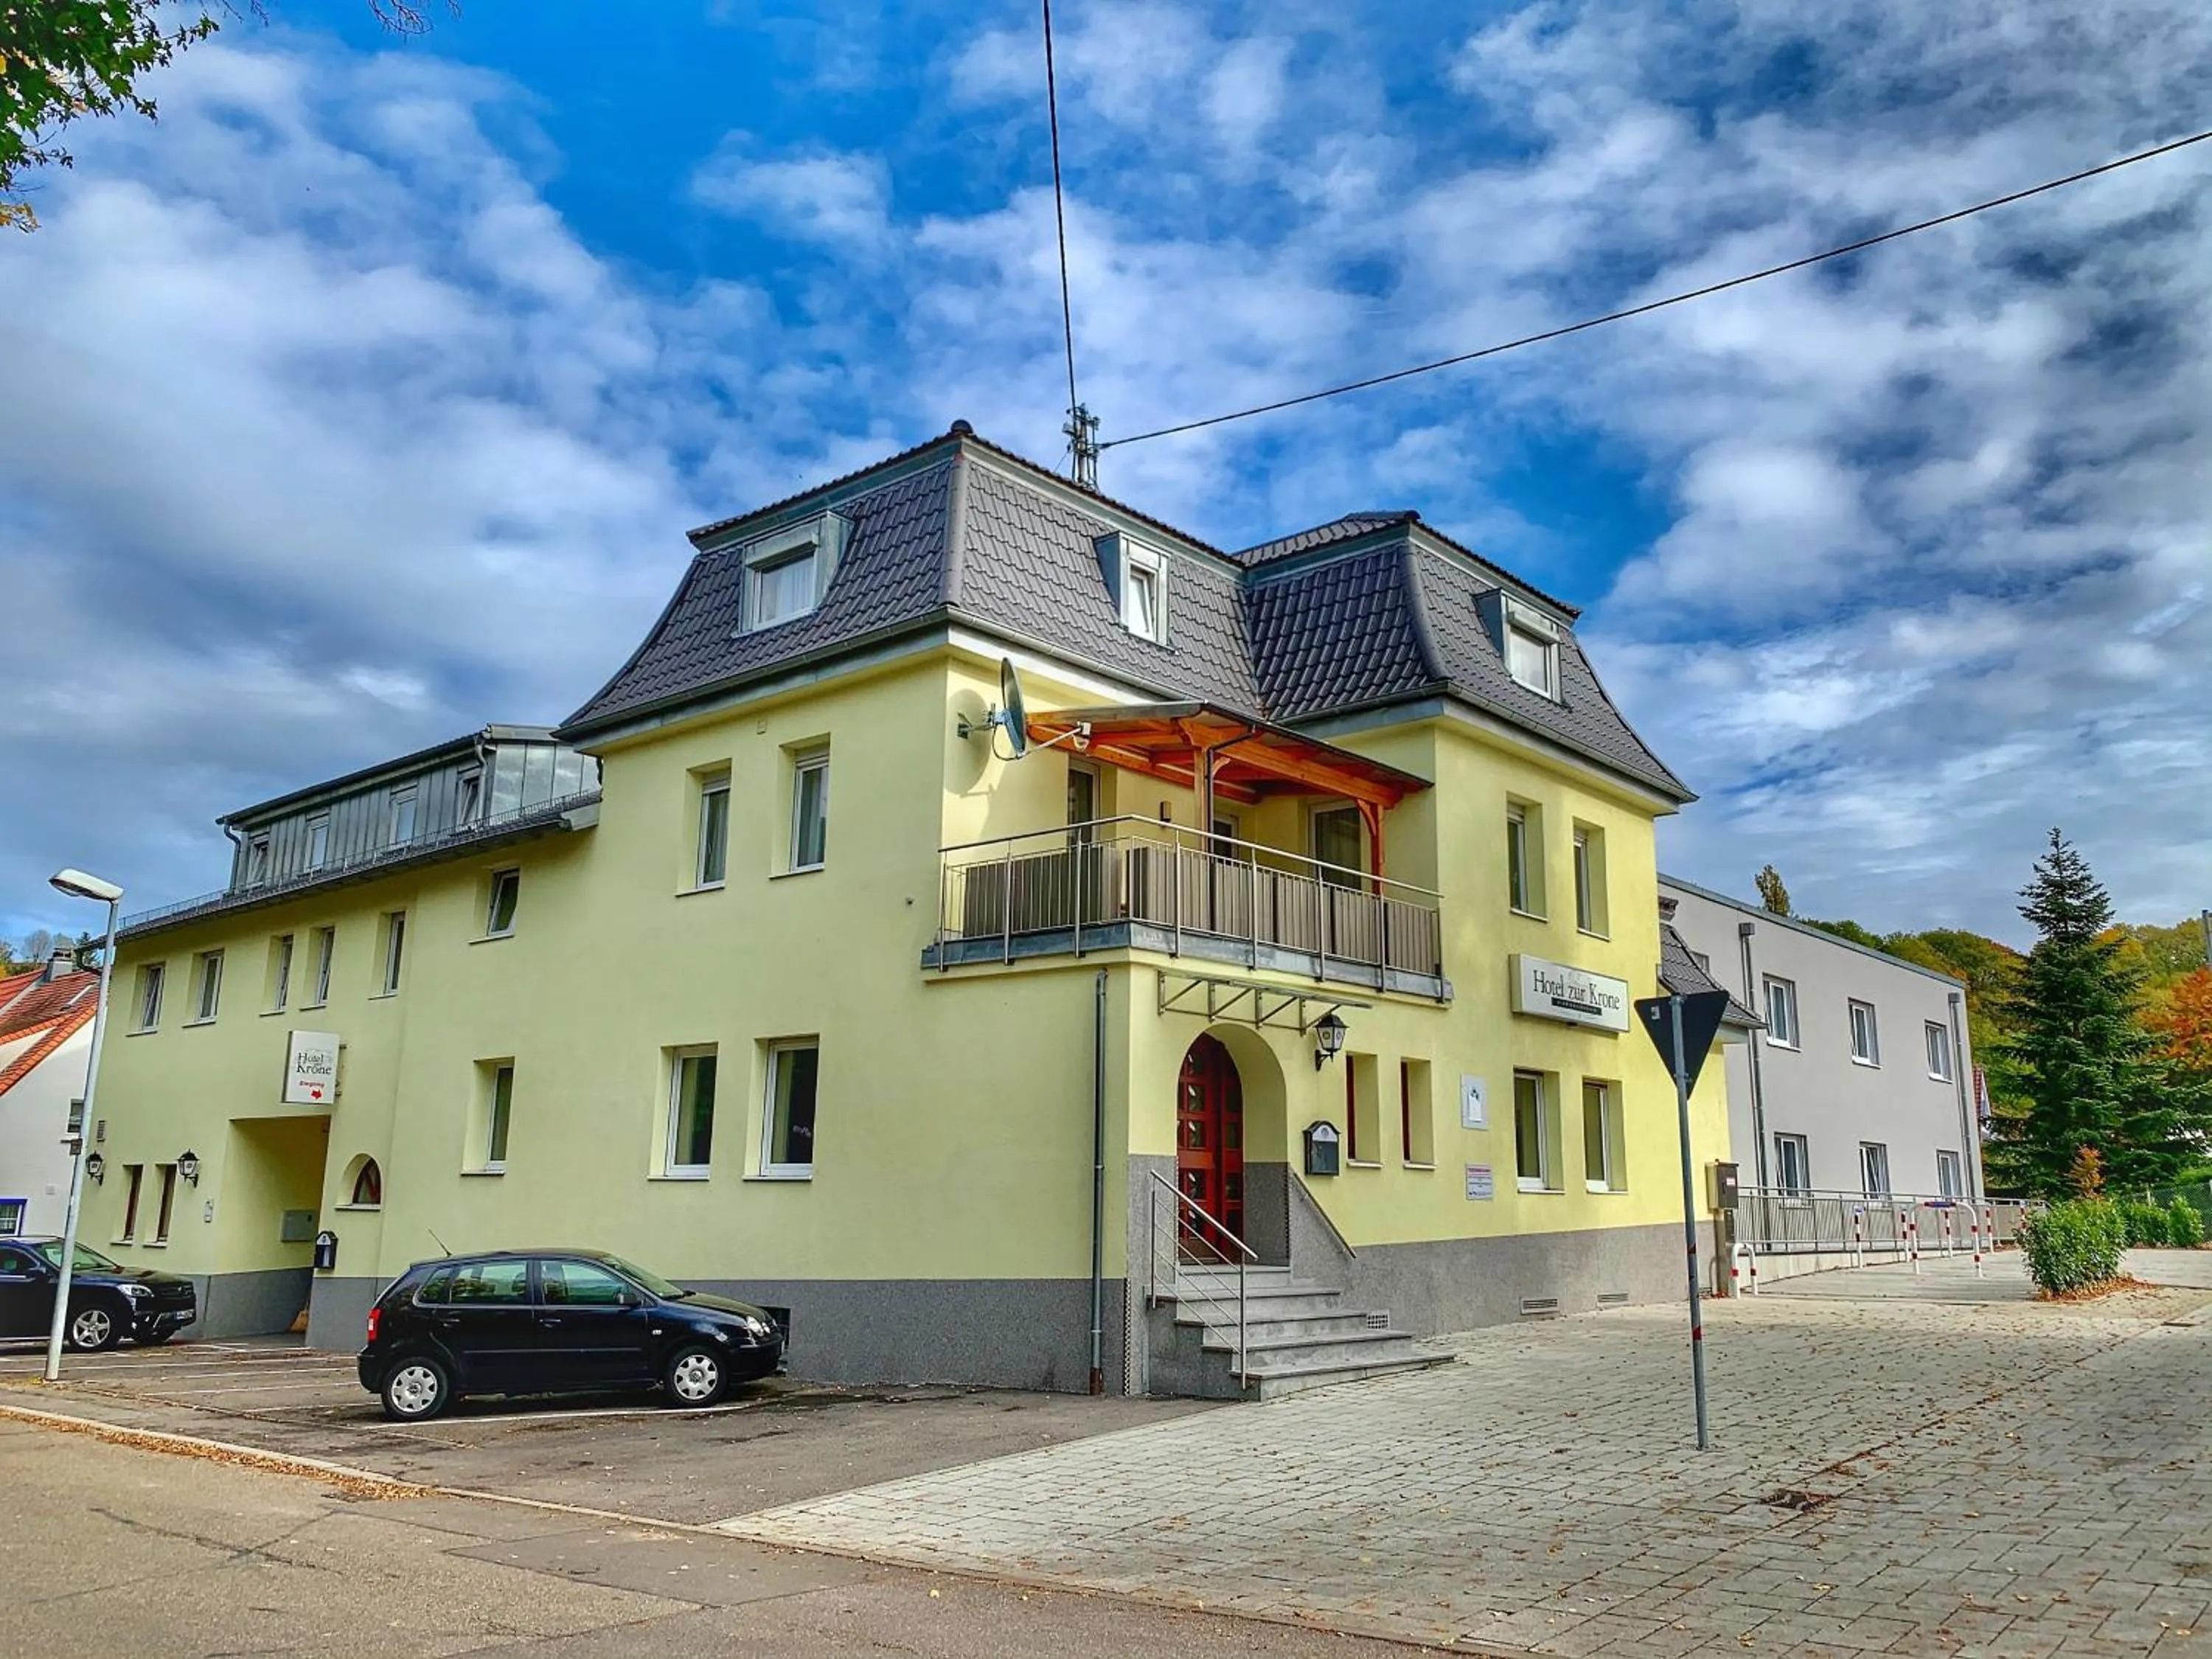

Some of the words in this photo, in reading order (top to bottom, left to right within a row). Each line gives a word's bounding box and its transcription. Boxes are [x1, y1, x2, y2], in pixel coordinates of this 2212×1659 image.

[1533, 970, 1565, 997] Hotel
[1568, 985, 1586, 1001] zur
[1589, 983, 1620, 1010] Krone
[298, 1052, 324, 1062] Hotel
[296, 1062, 332, 1074] Krone
